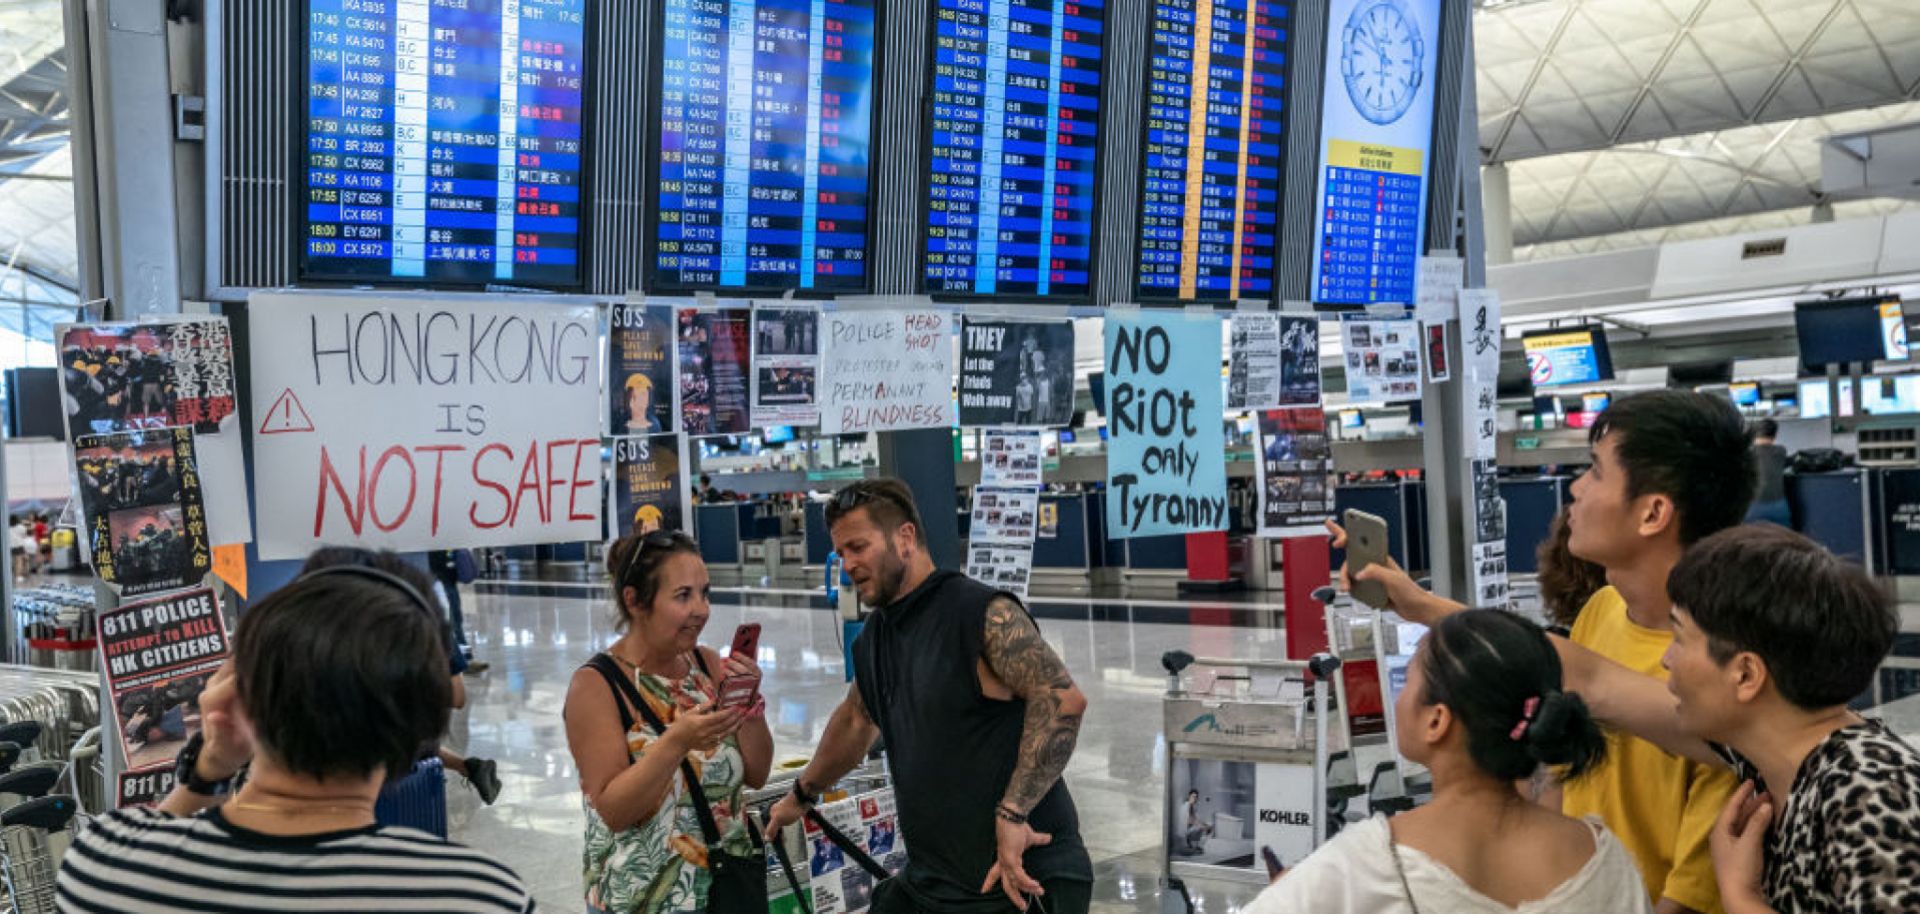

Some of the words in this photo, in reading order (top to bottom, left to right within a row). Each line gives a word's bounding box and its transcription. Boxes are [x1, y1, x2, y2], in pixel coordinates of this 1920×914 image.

[344, 157, 360, 168] CX
[432, 146, 454, 160] 台北
[344, 175, 359, 186] KA
[343, 210, 359, 220] CX
[343, 227, 358, 237] EY
[343, 243, 359, 254] CX
[613, 306, 644, 328] SOS
[831, 319, 895, 348] POLICE
[904, 314, 942, 332] HEAD
[904, 332, 942, 352] SHOT
[965, 325, 1006, 352] THEY
[1110, 324, 1171, 377] NO
[963, 356, 978, 371] Let
[978, 357, 995, 371] the
[962, 374, 993, 390] Triads
[962, 393, 985, 408] Walk
[985, 395, 1013, 409] away
[436, 404, 487, 436] IS
[841, 403, 943, 430] BLINDNESS
[617, 440, 649, 462] SOS
[1141, 440, 1199, 486] only
[314, 443, 467, 538] NOT
[469, 438, 602, 529] SAFE
[1111, 473, 1226, 533] Tyranny
[103, 613, 138, 636] 811
[142, 596, 212, 629] POLICE
[107, 632, 161, 656] ATTEMPT
[181, 617, 217, 638] KILL
[110, 657, 139, 675] HK
[141, 634, 223, 667] CITIZENS
[124, 775, 154, 797] 811
[1259, 809, 1311, 825] KOHLER
